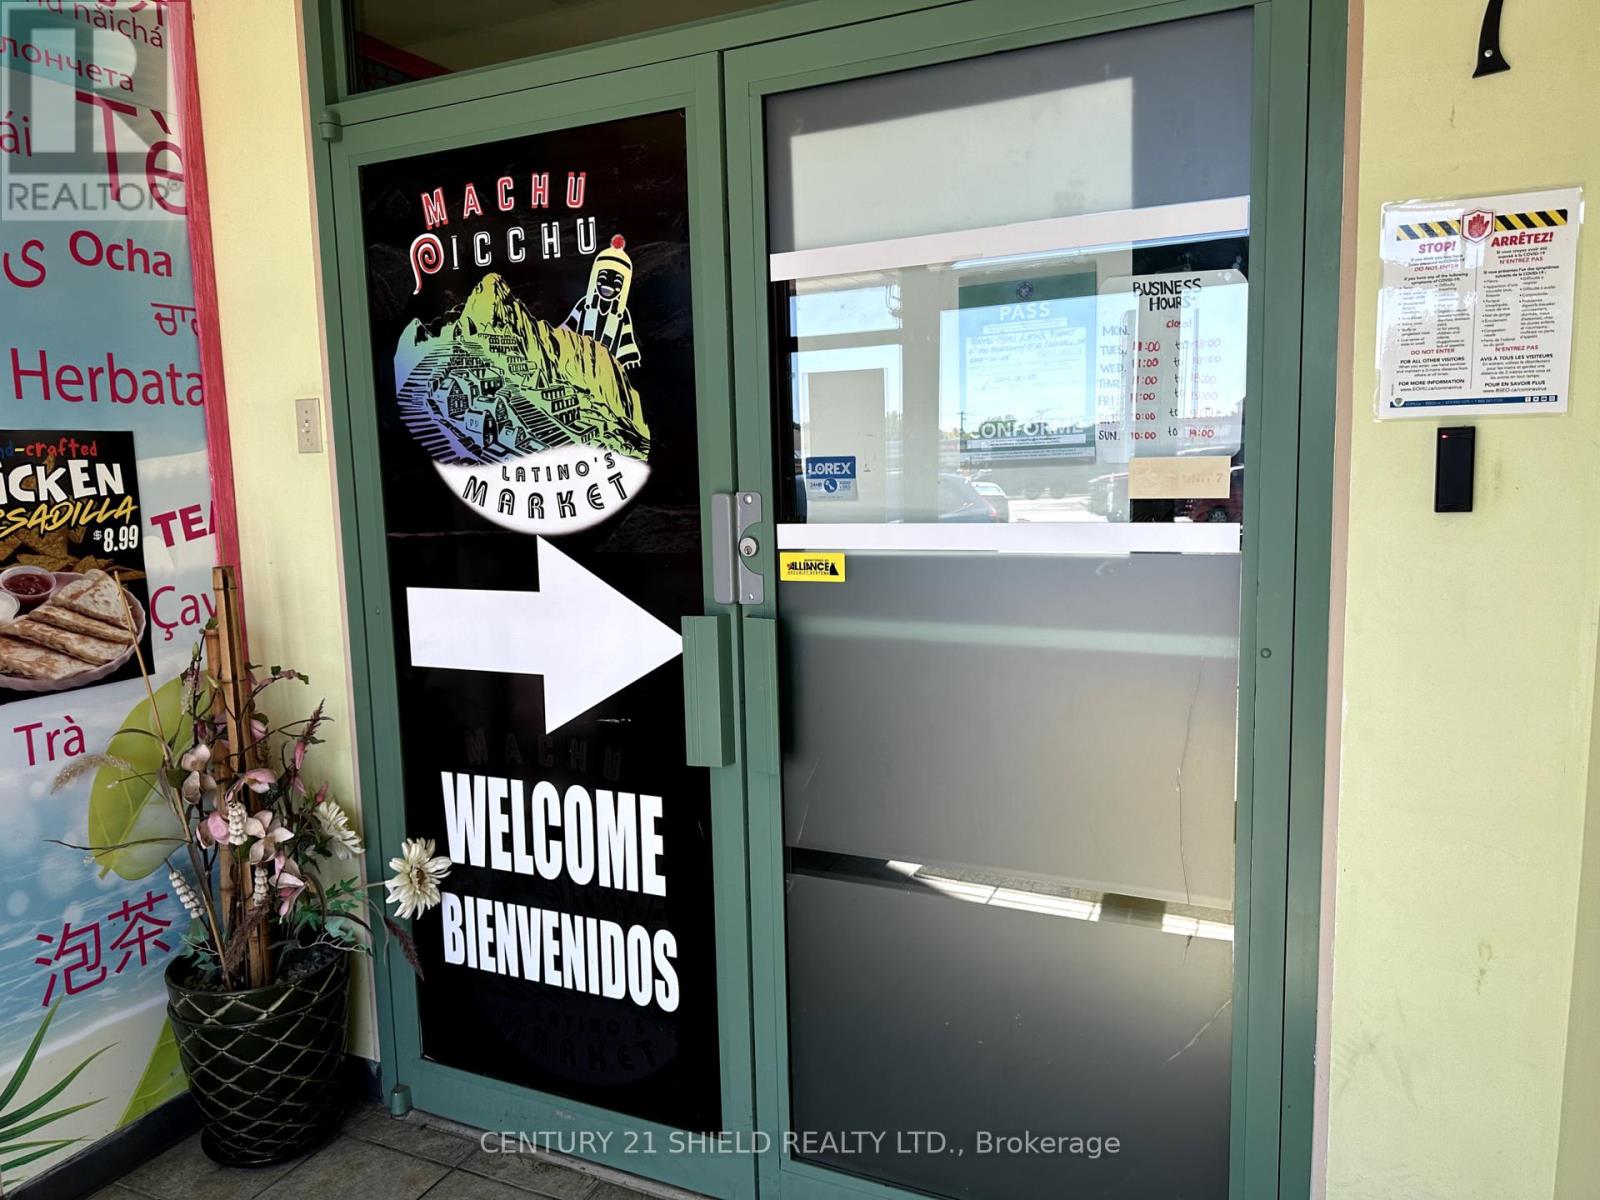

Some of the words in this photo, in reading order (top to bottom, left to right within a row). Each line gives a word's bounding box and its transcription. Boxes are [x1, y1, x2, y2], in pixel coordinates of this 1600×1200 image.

[420, 172, 587, 230] MACHU
[69, 230, 173, 278] Ocha
[1418, 241, 1456, 254] STOP!
[1491, 231, 1554, 248] ARRÊTEZ!
[409, 216, 597, 296] PICCHU
[1132, 278, 1202, 297] BUSINESS
[999, 301, 1051, 322] PASS
[1149, 296, 1191, 311] HOURS
[10, 347, 205, 407] Herbata
[1098, 430, 1121, 441] SUN.
[1167, 426, 1178, 437] to
[502, 452, 616, 482] LATINO'S
[808, 462, 852, 475] LOREX
[461, 471, 629, 519] MARKET
[93, 524, 139, 553] $8.99
[787, 562, 830, 573] ALLIANCE
[13, 715, 87, 767] Trà
[440, 771, 667, 897] WELCOME
[35, 890, 173, 1007] 泡茶
[441, 891, 680, 1013] BIENVENIDOS
